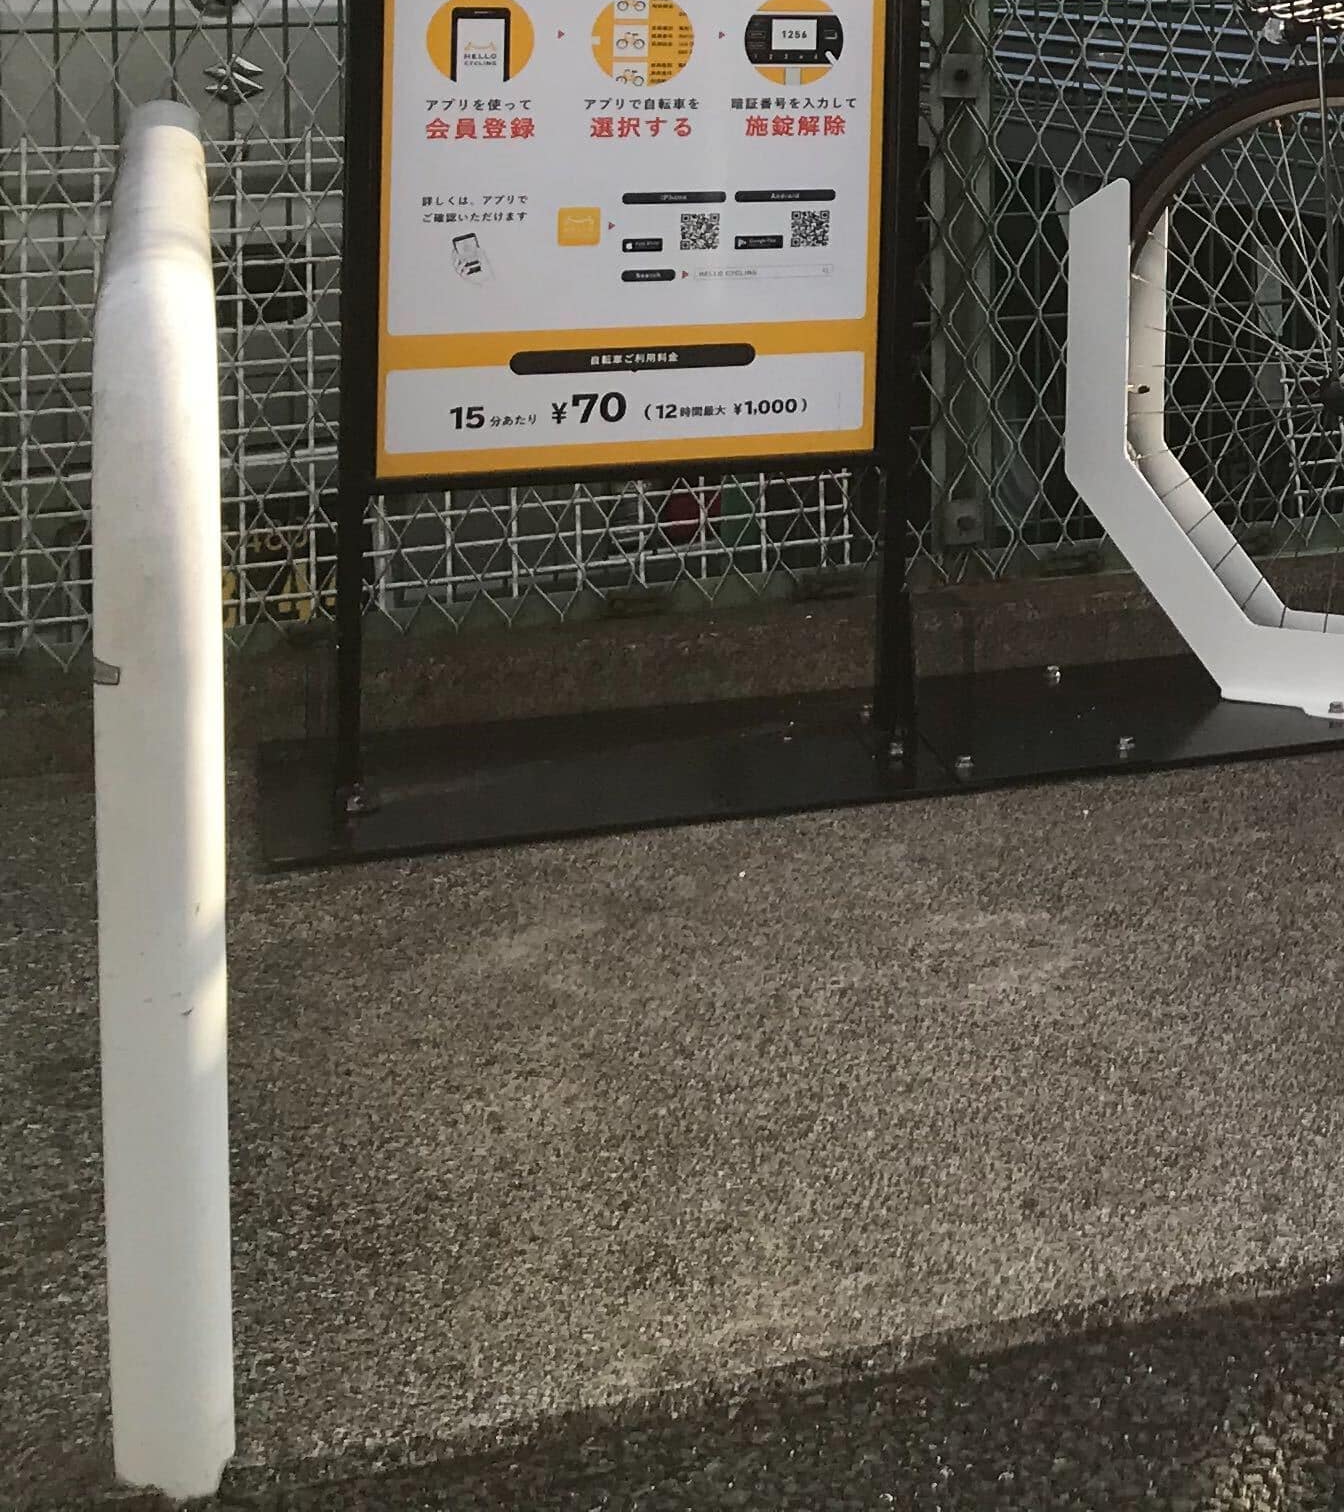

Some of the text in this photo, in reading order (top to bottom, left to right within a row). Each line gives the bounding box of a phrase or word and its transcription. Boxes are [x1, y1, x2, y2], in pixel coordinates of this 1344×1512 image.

[426, 98, 532, 112] アプリを使って
[584, 97, 700, 111] アプリで自転車を
[426, 117, 535, 140] 会員登録
[590, 116, 693, 139] 選択する
[745, 114, 846, 137] 施錠解除
[590, 351, 679, 365] 自転車ご利用料金
[551, 391, 627, 425] ¥70
